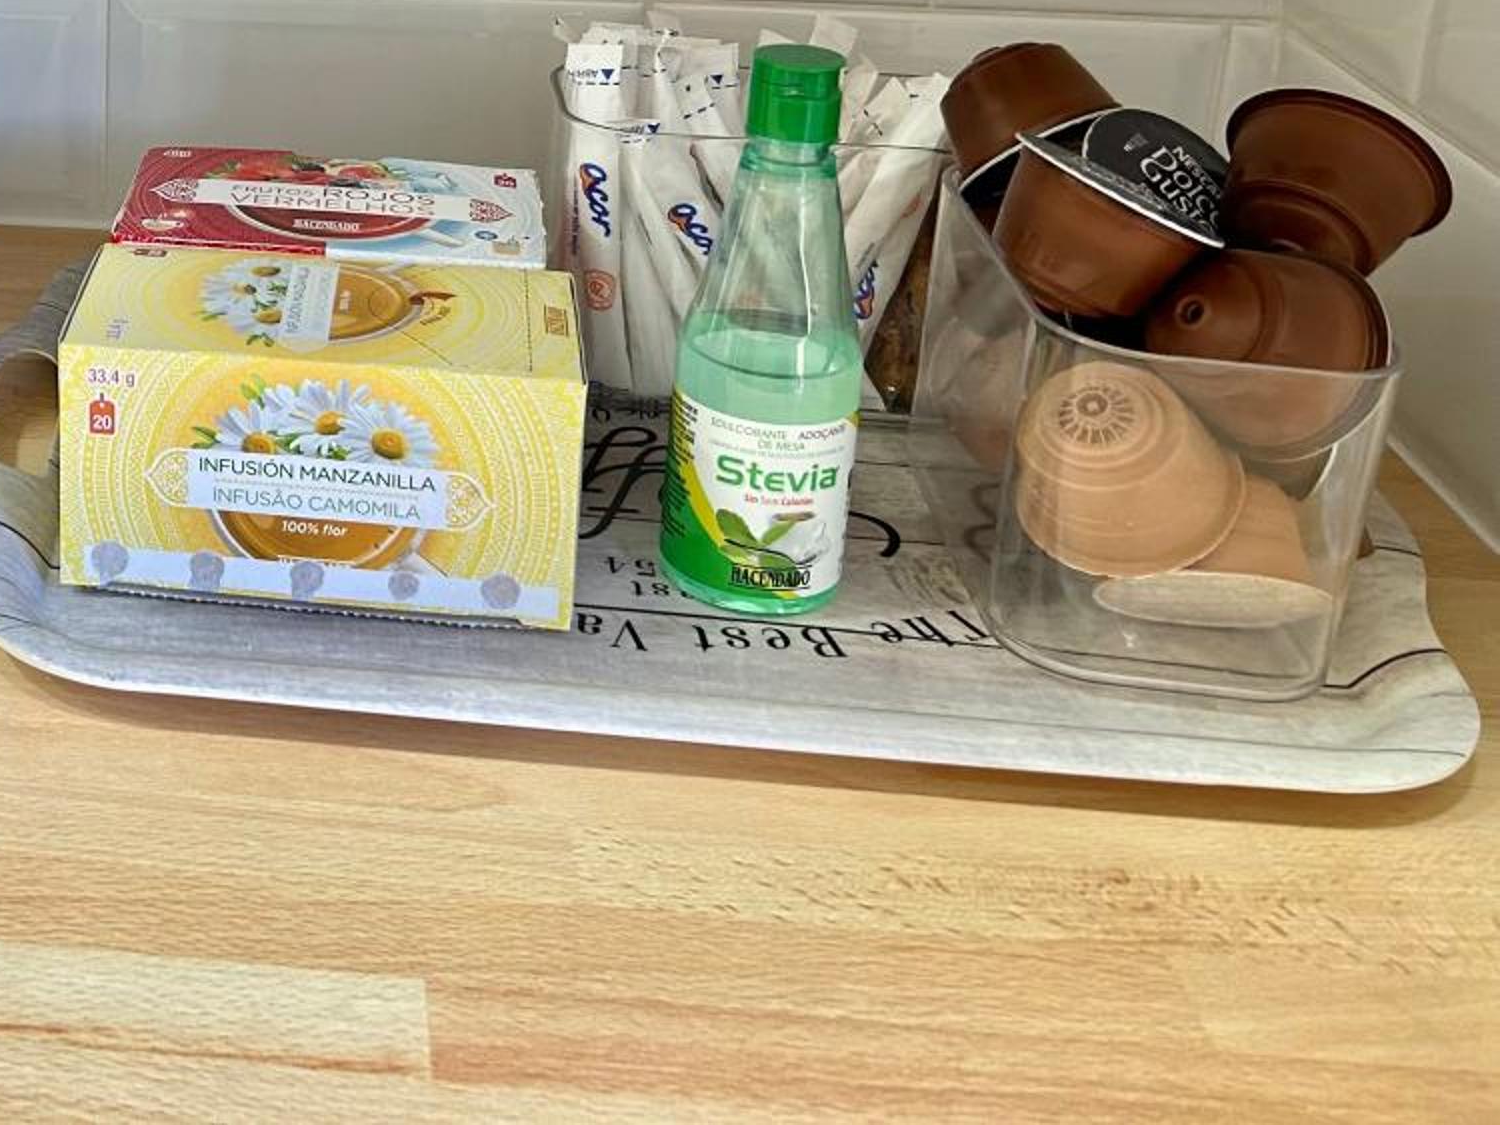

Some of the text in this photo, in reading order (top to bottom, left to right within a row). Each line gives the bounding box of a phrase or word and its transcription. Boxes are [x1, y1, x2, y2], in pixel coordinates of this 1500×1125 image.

[230, 191, 436, 216] VERMELHOS
[323, 188, 436, 206] ROJOS
[87, 368, 136, 388] 33,4 g
[92, 415, 112, 429] 20
[198, 454, 436, 493] INFUSIÓN MANZANILLA
[715, 454, 840, 493] Stevia
[212, 486, 421, 521] INFUSÃO CAMOMILA
[281, 518, 348, 537] 100% flor
[729, 565, 812, 587] HACENDADO
[576, 609, 990, 659] The Best Va
